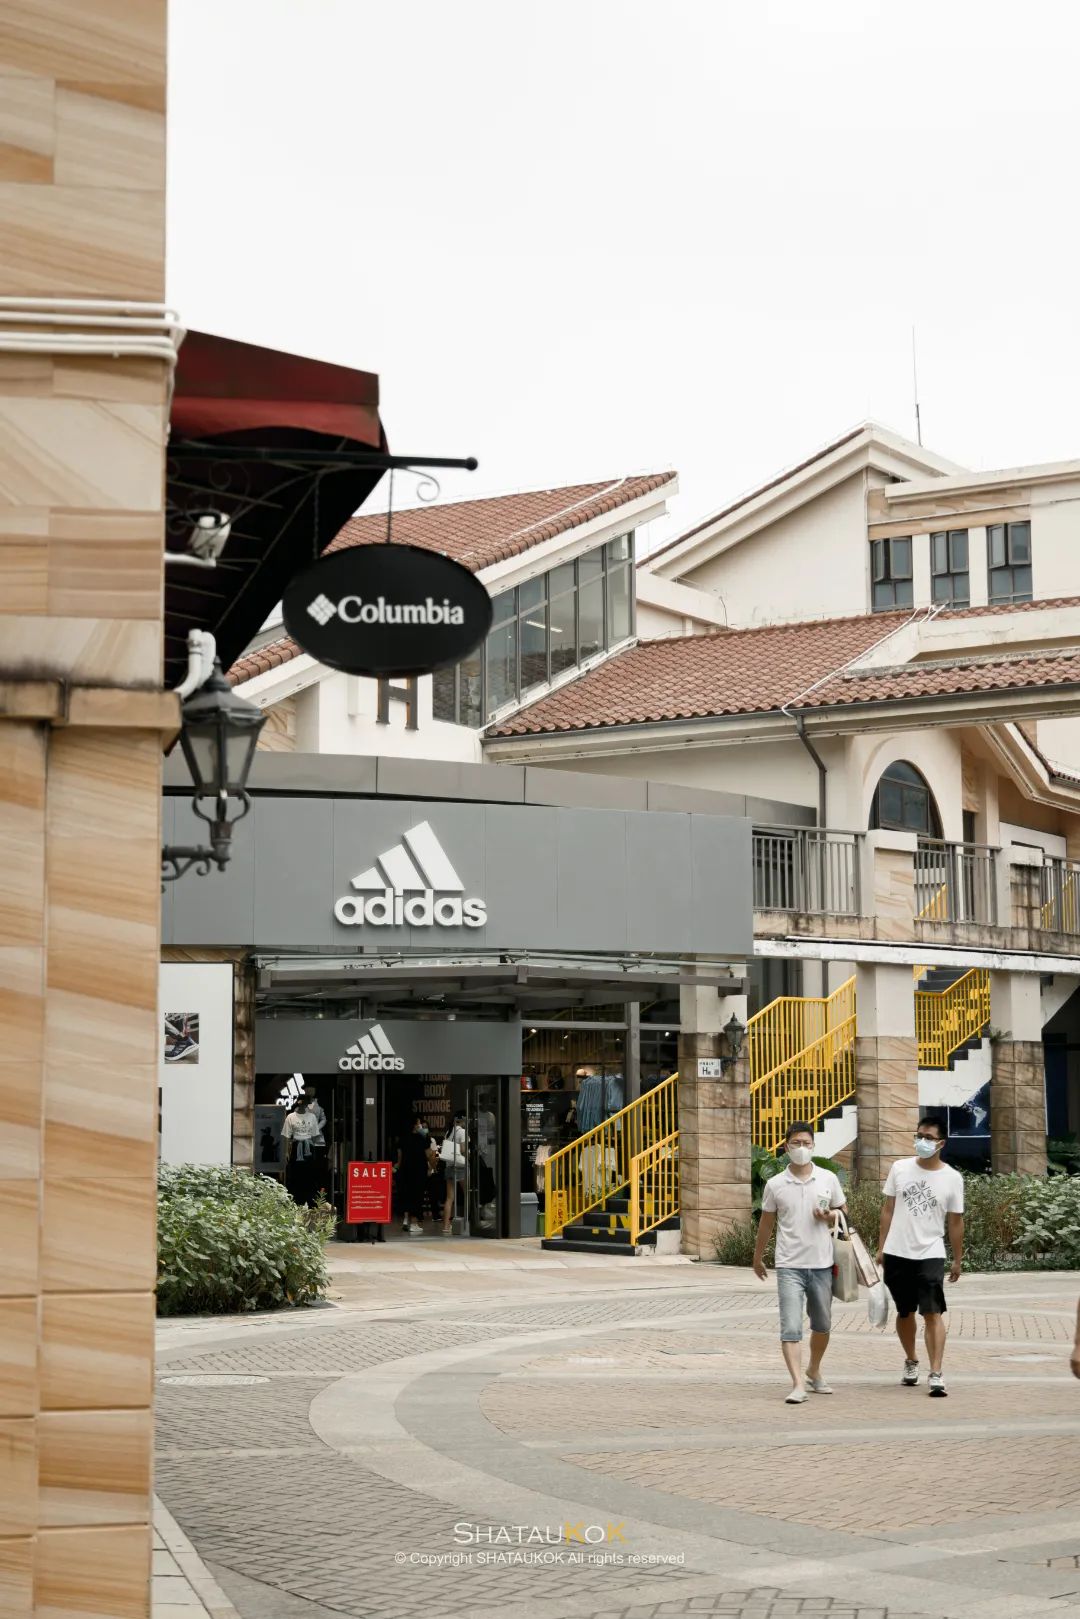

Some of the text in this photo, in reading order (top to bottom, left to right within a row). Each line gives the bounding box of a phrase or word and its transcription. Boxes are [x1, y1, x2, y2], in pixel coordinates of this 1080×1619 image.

[337, 595, 465, 625] Columbia
[333, 887, 488, 928] adidas
[338, 1053, 405, 1071] adidas
[353, 1167, 387, 1178] SALE
